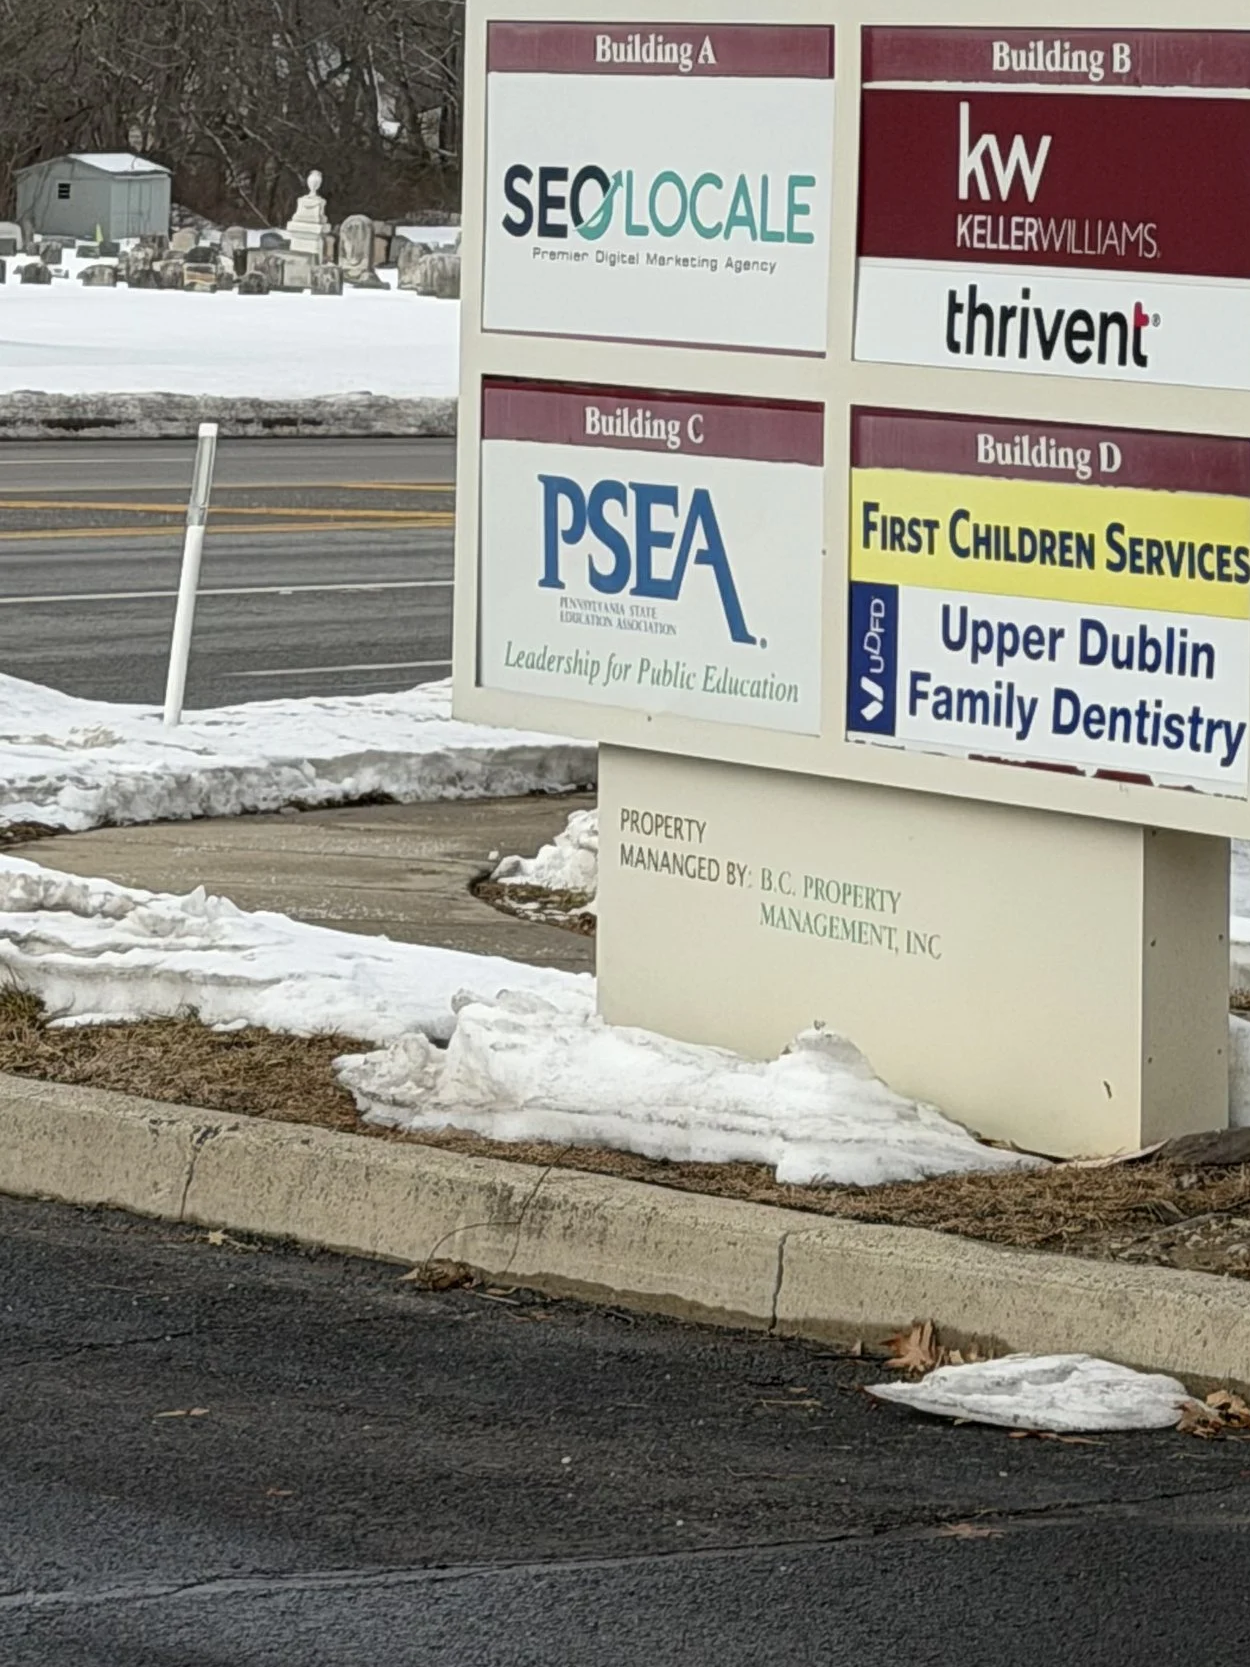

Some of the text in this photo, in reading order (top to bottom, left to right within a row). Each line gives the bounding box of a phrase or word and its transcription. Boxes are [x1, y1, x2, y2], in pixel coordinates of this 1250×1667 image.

[595, 34, 717, 72] Building A
[992, 40, 1132, 82] Building B
[532, 247, 777, 275] Premier Digital Marketing Agency
[585, 407, 705, 447] Building C
[977, 433, 1122, 479] Building D
[941, 604, 1216, 679] Upper Dublin
[504, 641, 799, 703] Leadership for Public Education
[909, 671, 1247, 767] Family Dentistry
[620, 808, 707, 844] PROPERTY
[620, 843, 902, 914] MANANGED BY: B.C. PROPERTY
[760, 902, 943, 960] MANAGEMENT, INC
